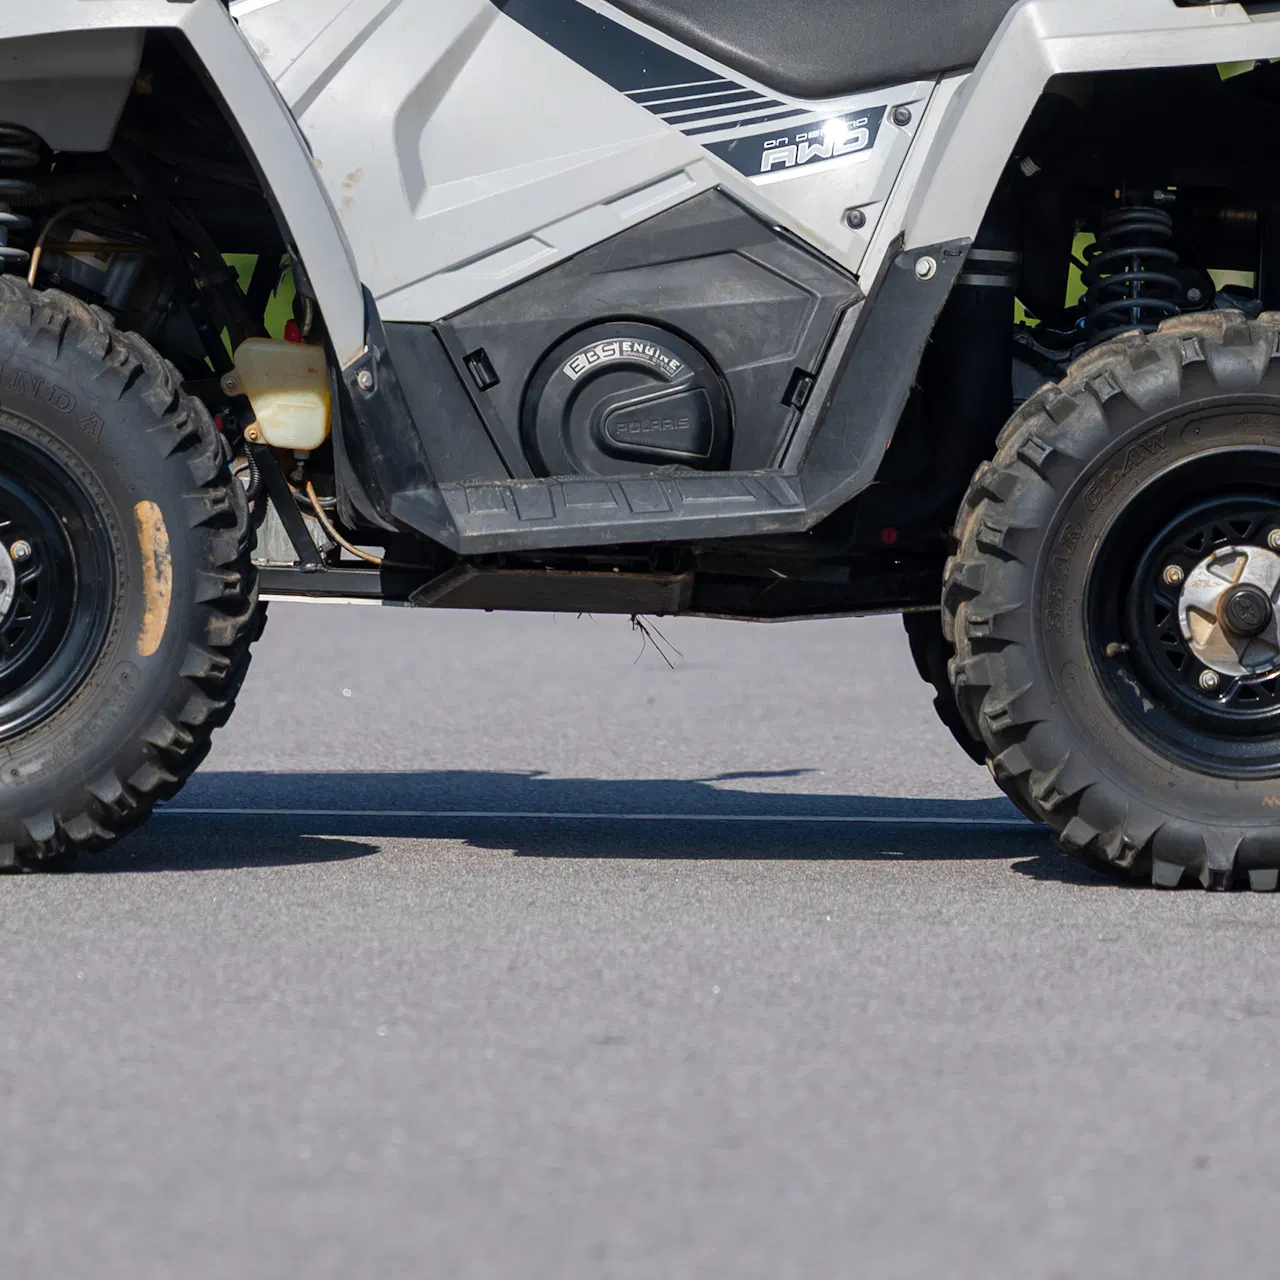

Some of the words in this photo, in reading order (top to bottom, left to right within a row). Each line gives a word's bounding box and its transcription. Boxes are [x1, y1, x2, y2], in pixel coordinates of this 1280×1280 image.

[760, 128, 870, 172] AWD
[567, 342, 618, 377] EBS
[622, 341, 680, 370] ENGINE
[616, 417, 689, 434] POLARIS
[1046, 523, 1083, 634] BEAR
[1084, 426, 1168, 511] CLAW
